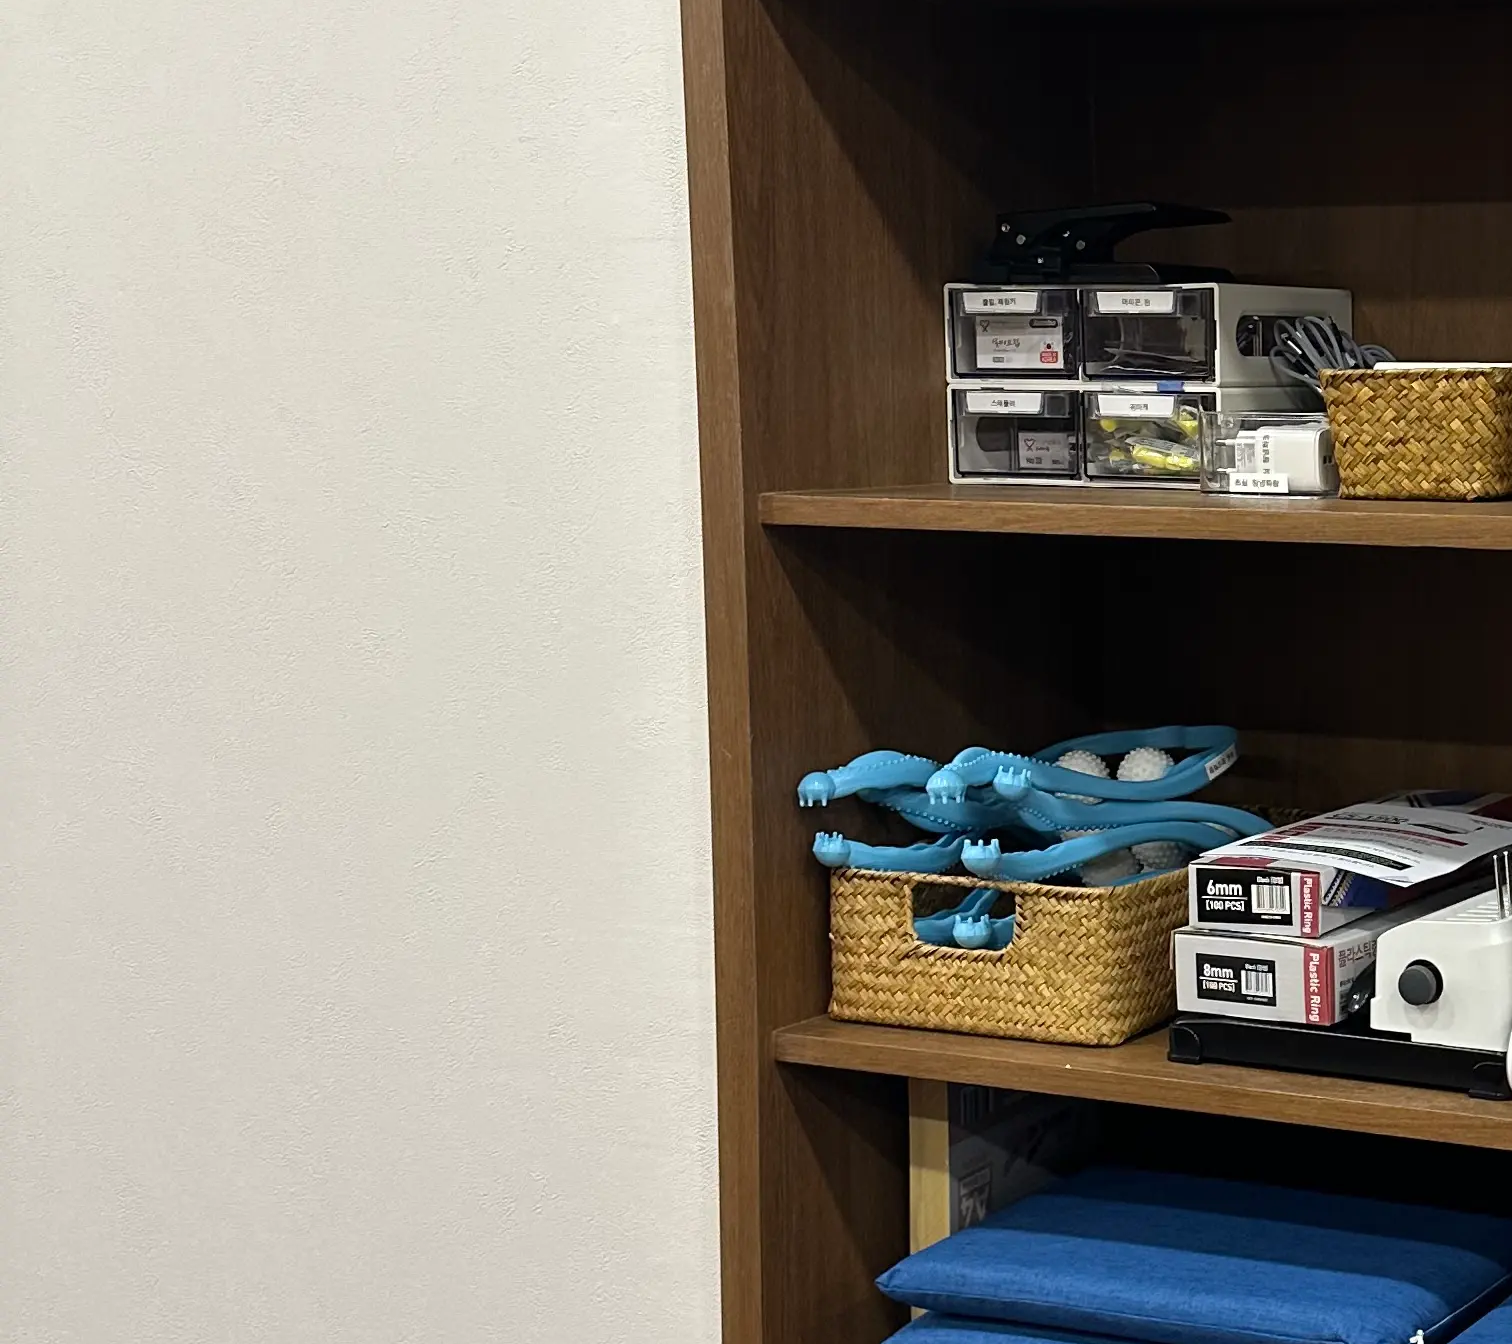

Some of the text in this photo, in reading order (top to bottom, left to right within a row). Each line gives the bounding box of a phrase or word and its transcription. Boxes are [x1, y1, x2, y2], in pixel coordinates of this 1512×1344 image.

[1206, 879, 1243, 896] 6mm
[1205, 899, 1245, 912] [100 PCS]
[1302, 877, 1313, 934] Plastic Ring
[1203, 963, 1234, 979] 8mm
[1218, 982, 1236, 993] PCS]
[1308, 952, 1321, 1022] Plastic Ring
